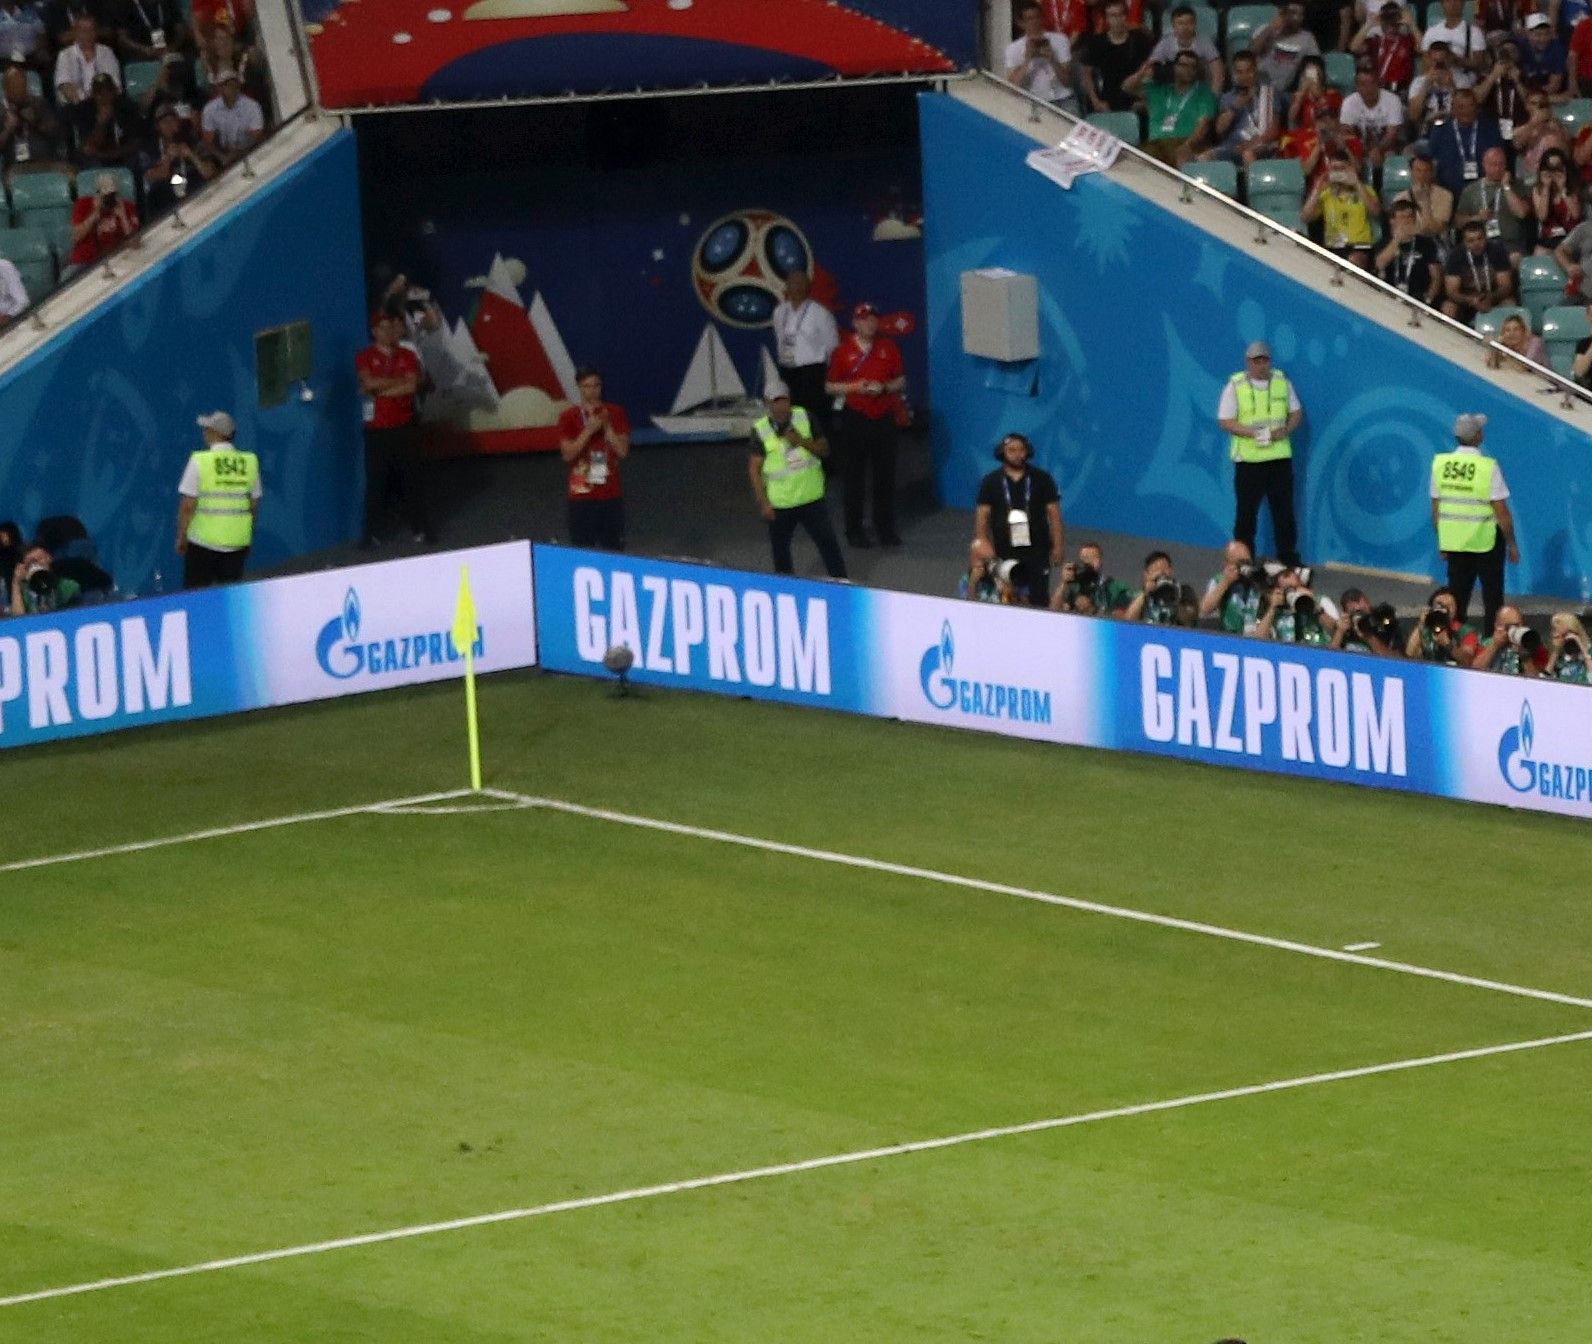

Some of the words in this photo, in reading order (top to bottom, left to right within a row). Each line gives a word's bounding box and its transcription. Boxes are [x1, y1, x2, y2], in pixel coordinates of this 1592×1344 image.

[573, 566, 832, 695] GAZPROM
[959, 679, 1051, 724] GAZPROM
[1140, 643, 1407, 777] GAZPROM
